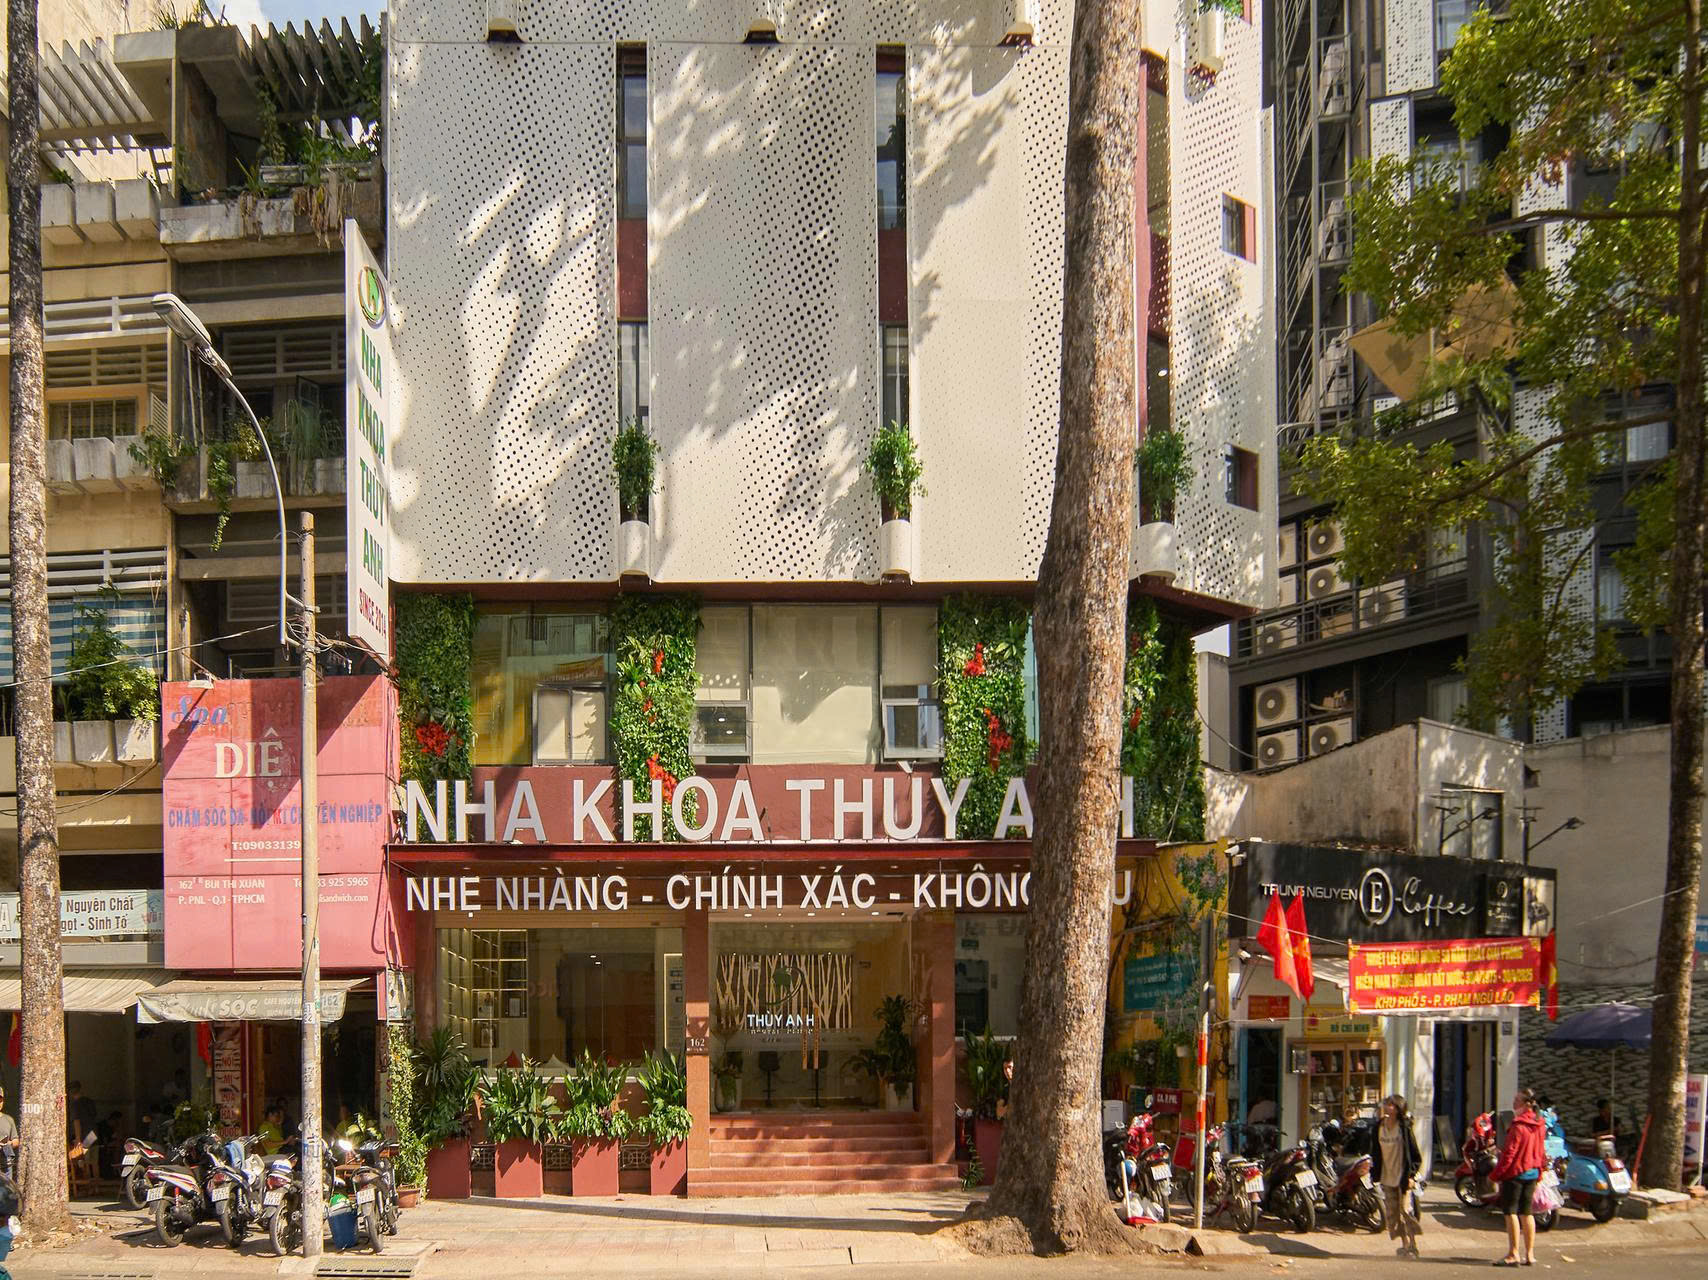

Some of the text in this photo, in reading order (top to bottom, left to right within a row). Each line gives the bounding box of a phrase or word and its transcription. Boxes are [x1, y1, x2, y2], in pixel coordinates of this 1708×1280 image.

[361, 327, 383, 399] NHA
[358, 386, 386, 466] KHOA
[359, 457, 385, 527] THÙY
[363, 528, 383, 589] ANH
[360, 588, 386, 641] SINCE 2014
[171, 696, 228, 731] Spa
[406, 780, 547, 842] NHA
[572, 775, 765, 842] KHOA
[785, 761, 973, 841] THÙY
[66, 894, 134, 914] Nguyên Chất
[406, 876, 481, 918] NHẸ
[496, 867, 628, 911] NHÀNG
[666, 865, 783, 911] CHÍNH
[800, 865, 876, 909] XÁC
[61, 918, 78, 934] gọt
[88, 916, 112, 931] Sinh
[219, 994, 258, 1018] SÓC
[747, 1010, 814, 1027] THÙY ANH
[690, 1038, 705, 1047] 162
